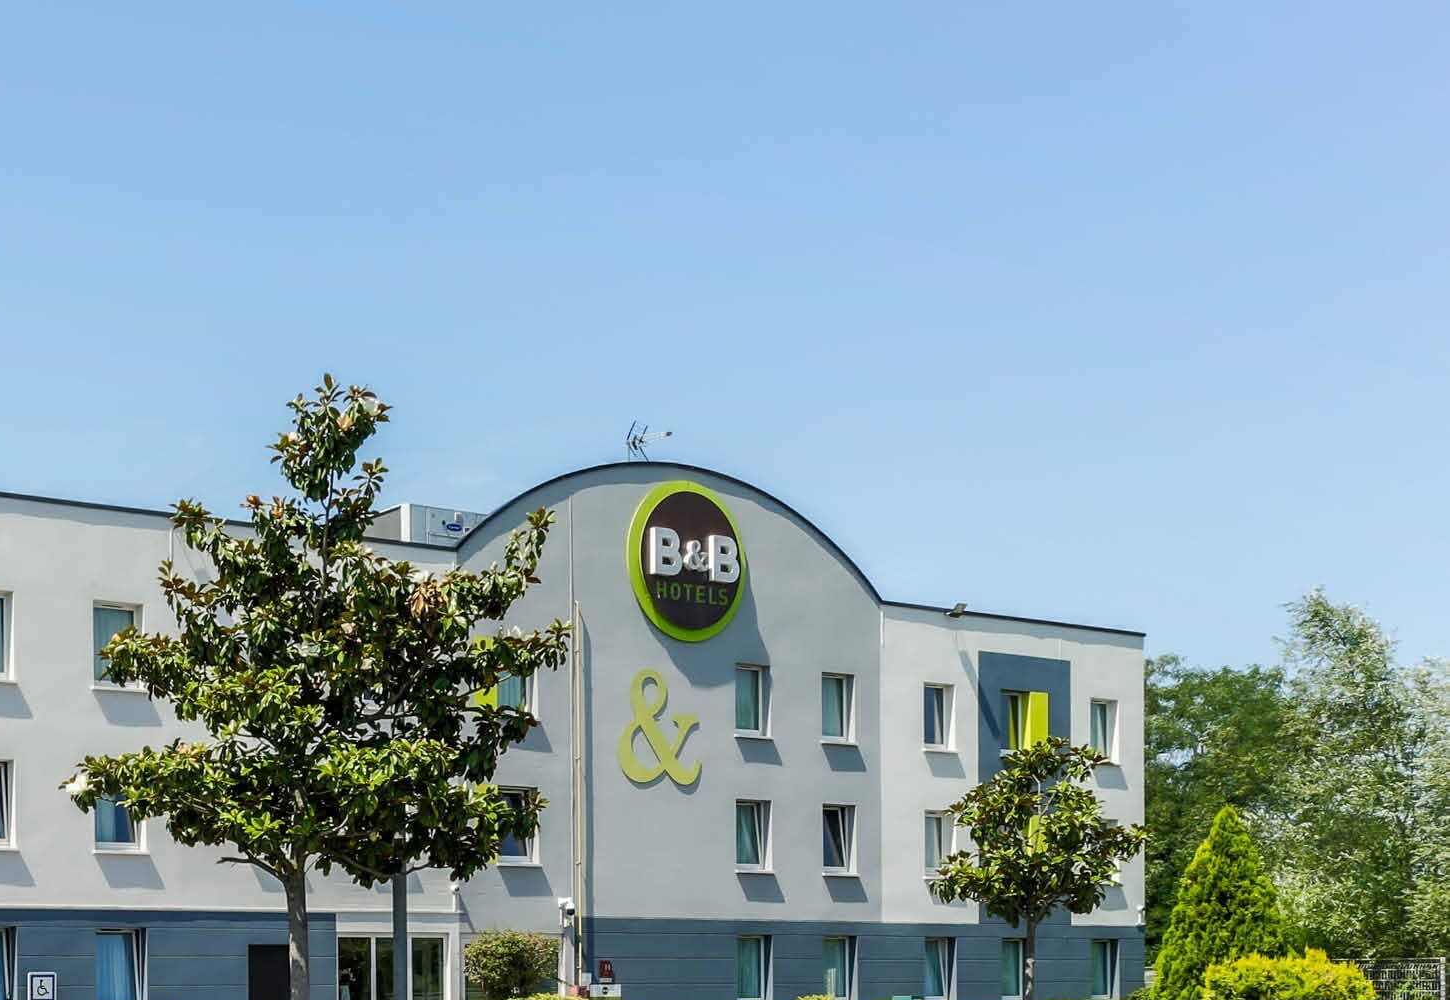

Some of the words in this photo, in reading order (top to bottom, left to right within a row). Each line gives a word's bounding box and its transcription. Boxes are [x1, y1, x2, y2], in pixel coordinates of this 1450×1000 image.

[649, 526, 740, 583] B&B
[656, 580, 728, 606] HOTELS
[617, 668, 702, 785] &
